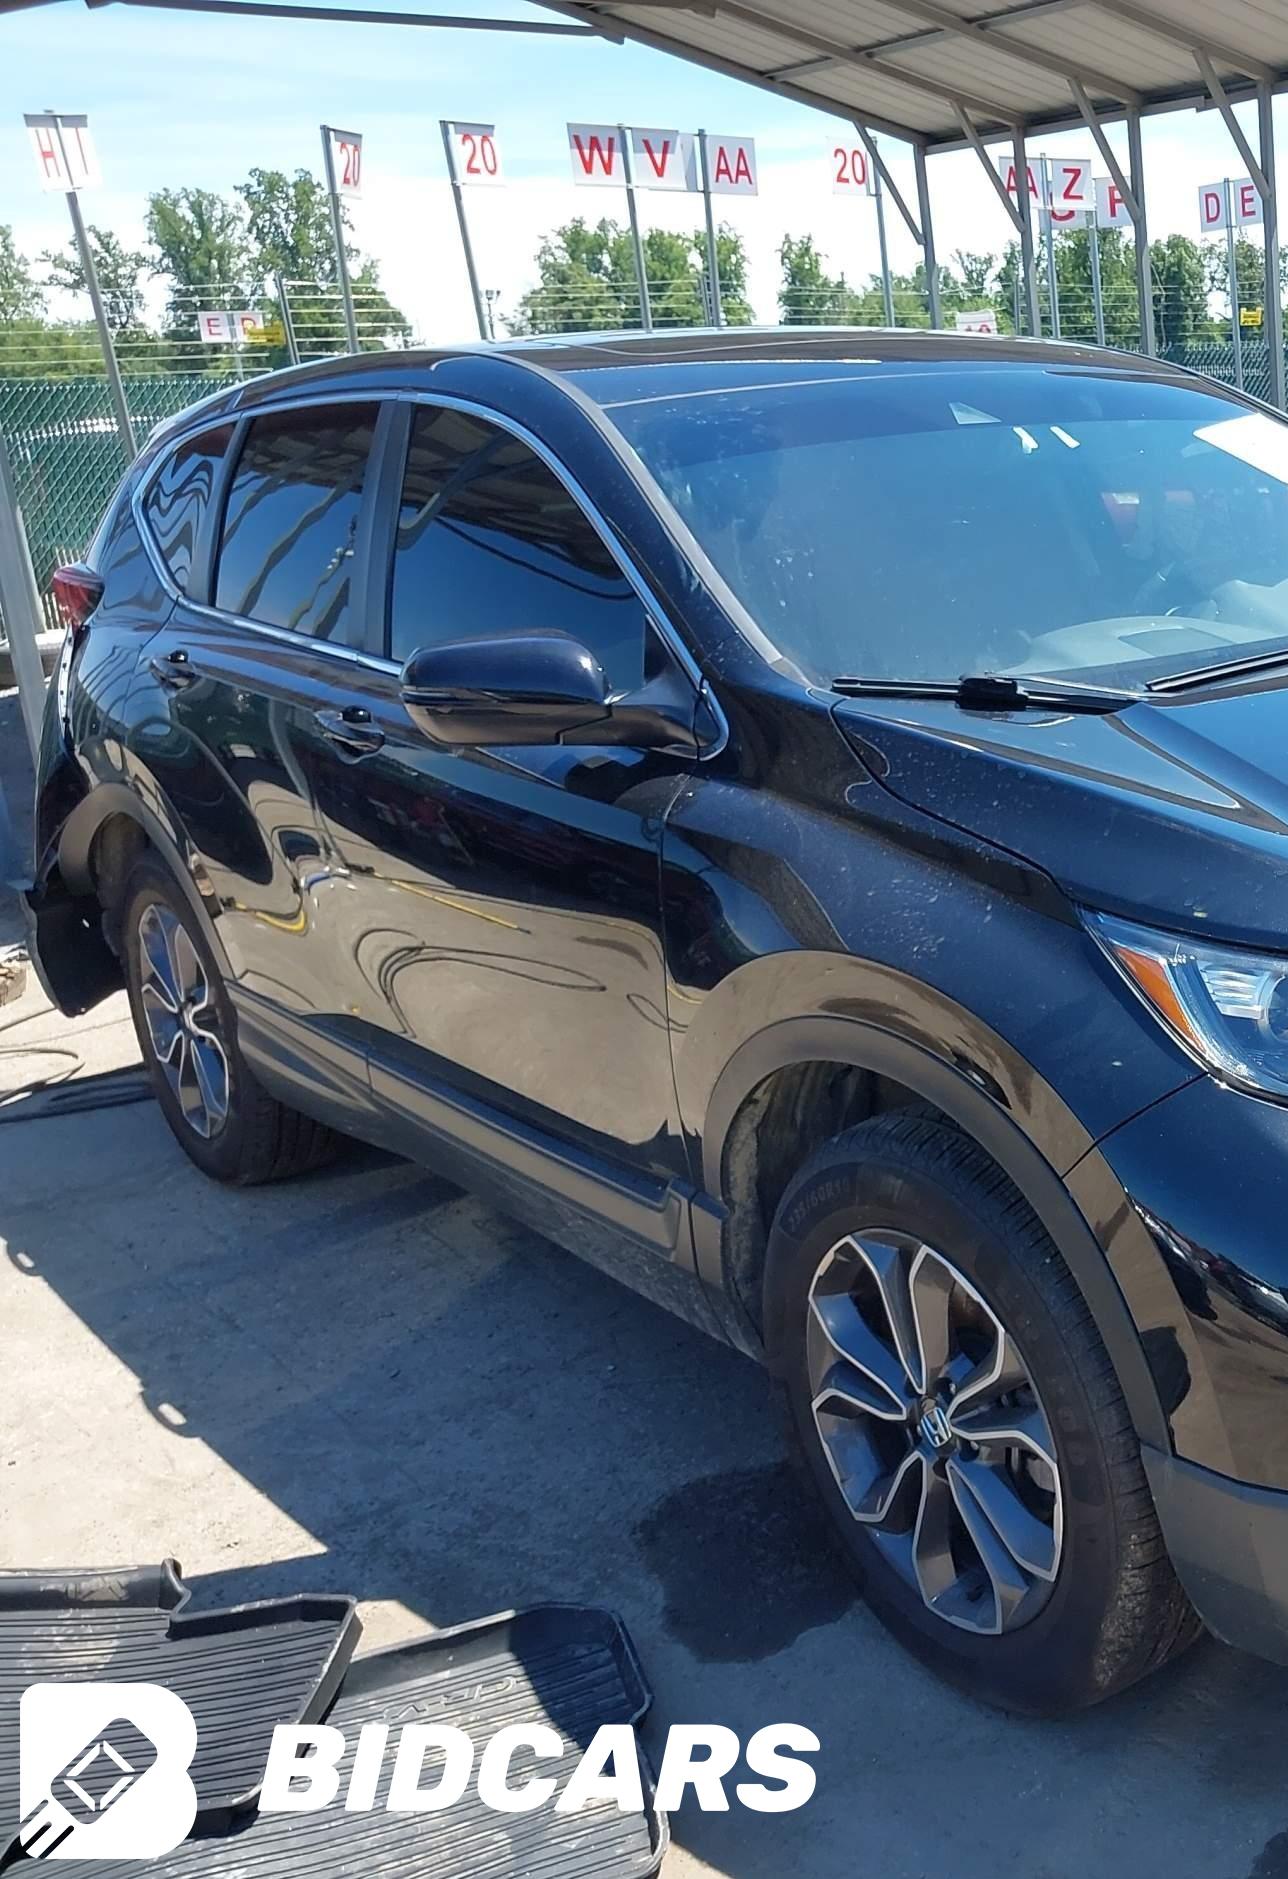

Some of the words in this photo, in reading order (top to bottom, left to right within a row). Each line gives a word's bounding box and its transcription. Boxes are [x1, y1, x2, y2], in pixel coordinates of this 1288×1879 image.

[339, 142, 361, 187] 20
[462, 134, 498, 175] 20
[573, 134, 615, 176] W
[643, 138, 670, 178] V
[715, 146, 753, 185] AA
[833, 148, 866, 185] 20
[1062, 167, 1083, 200] Z
[1240, 185, 1256, 217] E
[1205, 192, 1220, 224] D
[206, 317, 223, 335] E
